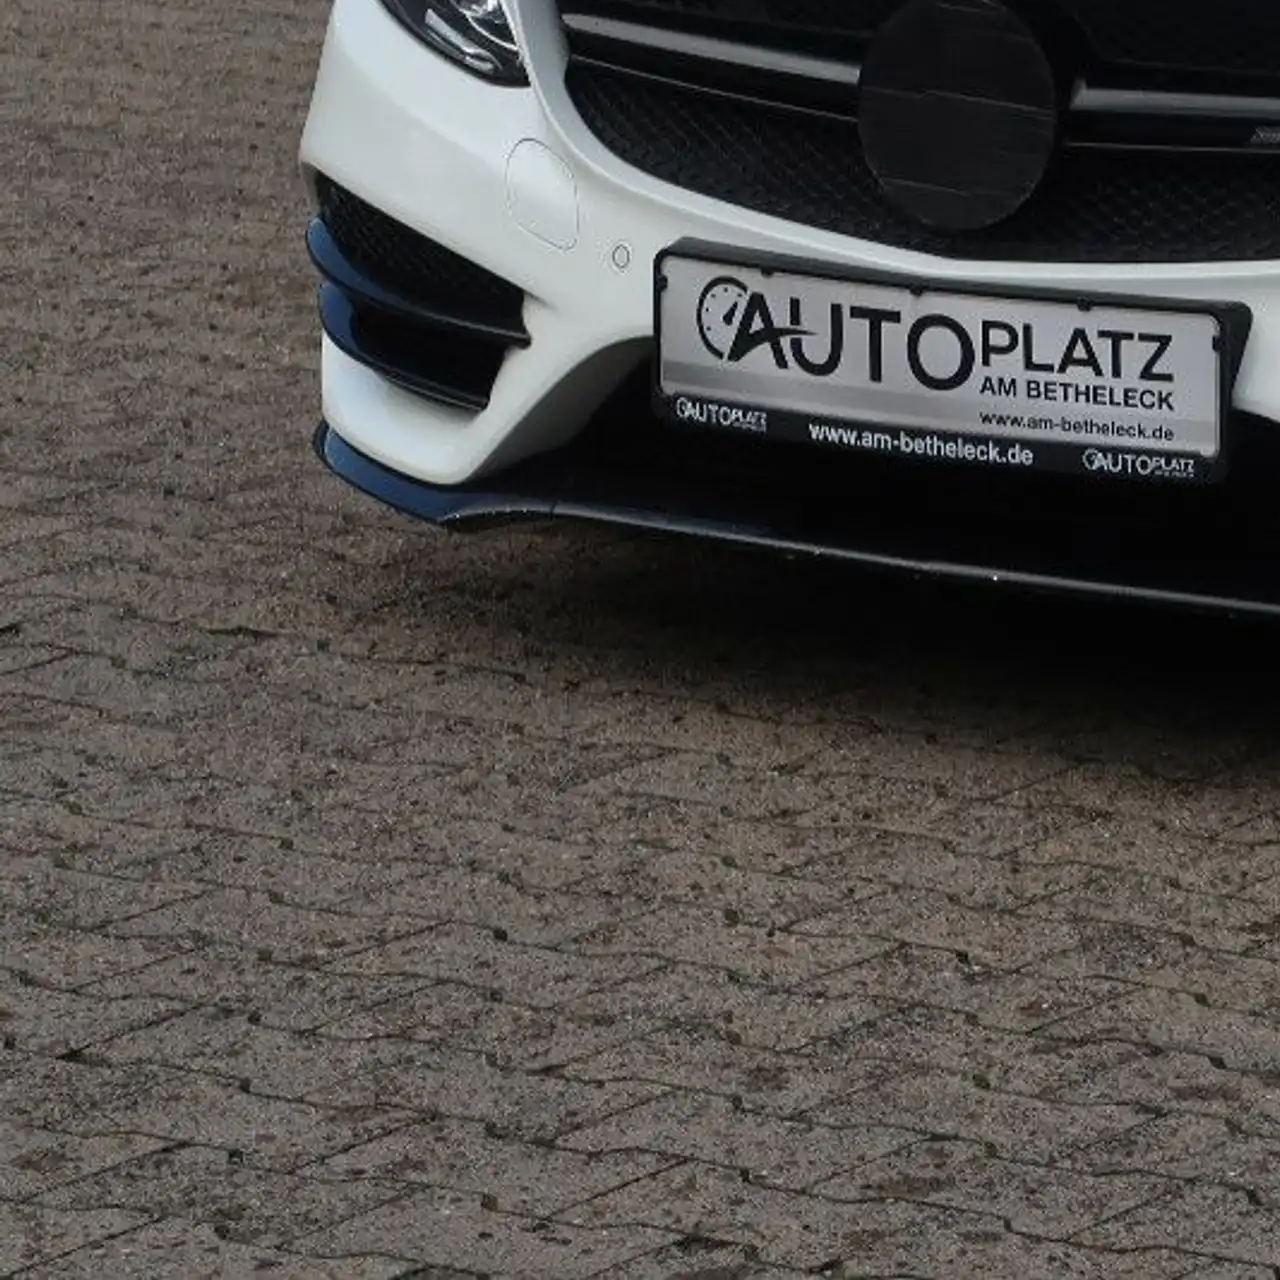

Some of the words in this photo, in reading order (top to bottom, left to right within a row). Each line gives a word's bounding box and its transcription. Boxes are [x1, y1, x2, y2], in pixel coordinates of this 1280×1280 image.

[724, 290, 1175, 391] AUTOPLATZ
[979, 376, 1017, 398] AM
[1026, 380, 1175, 412] BETHELECK
[808, 422, 1034, 465] www.am-betheleck.de
[979, 412, 1175, 441] www.am-betheleck.de
[1088, 449, 1194, 475] AUTOPLATZ
